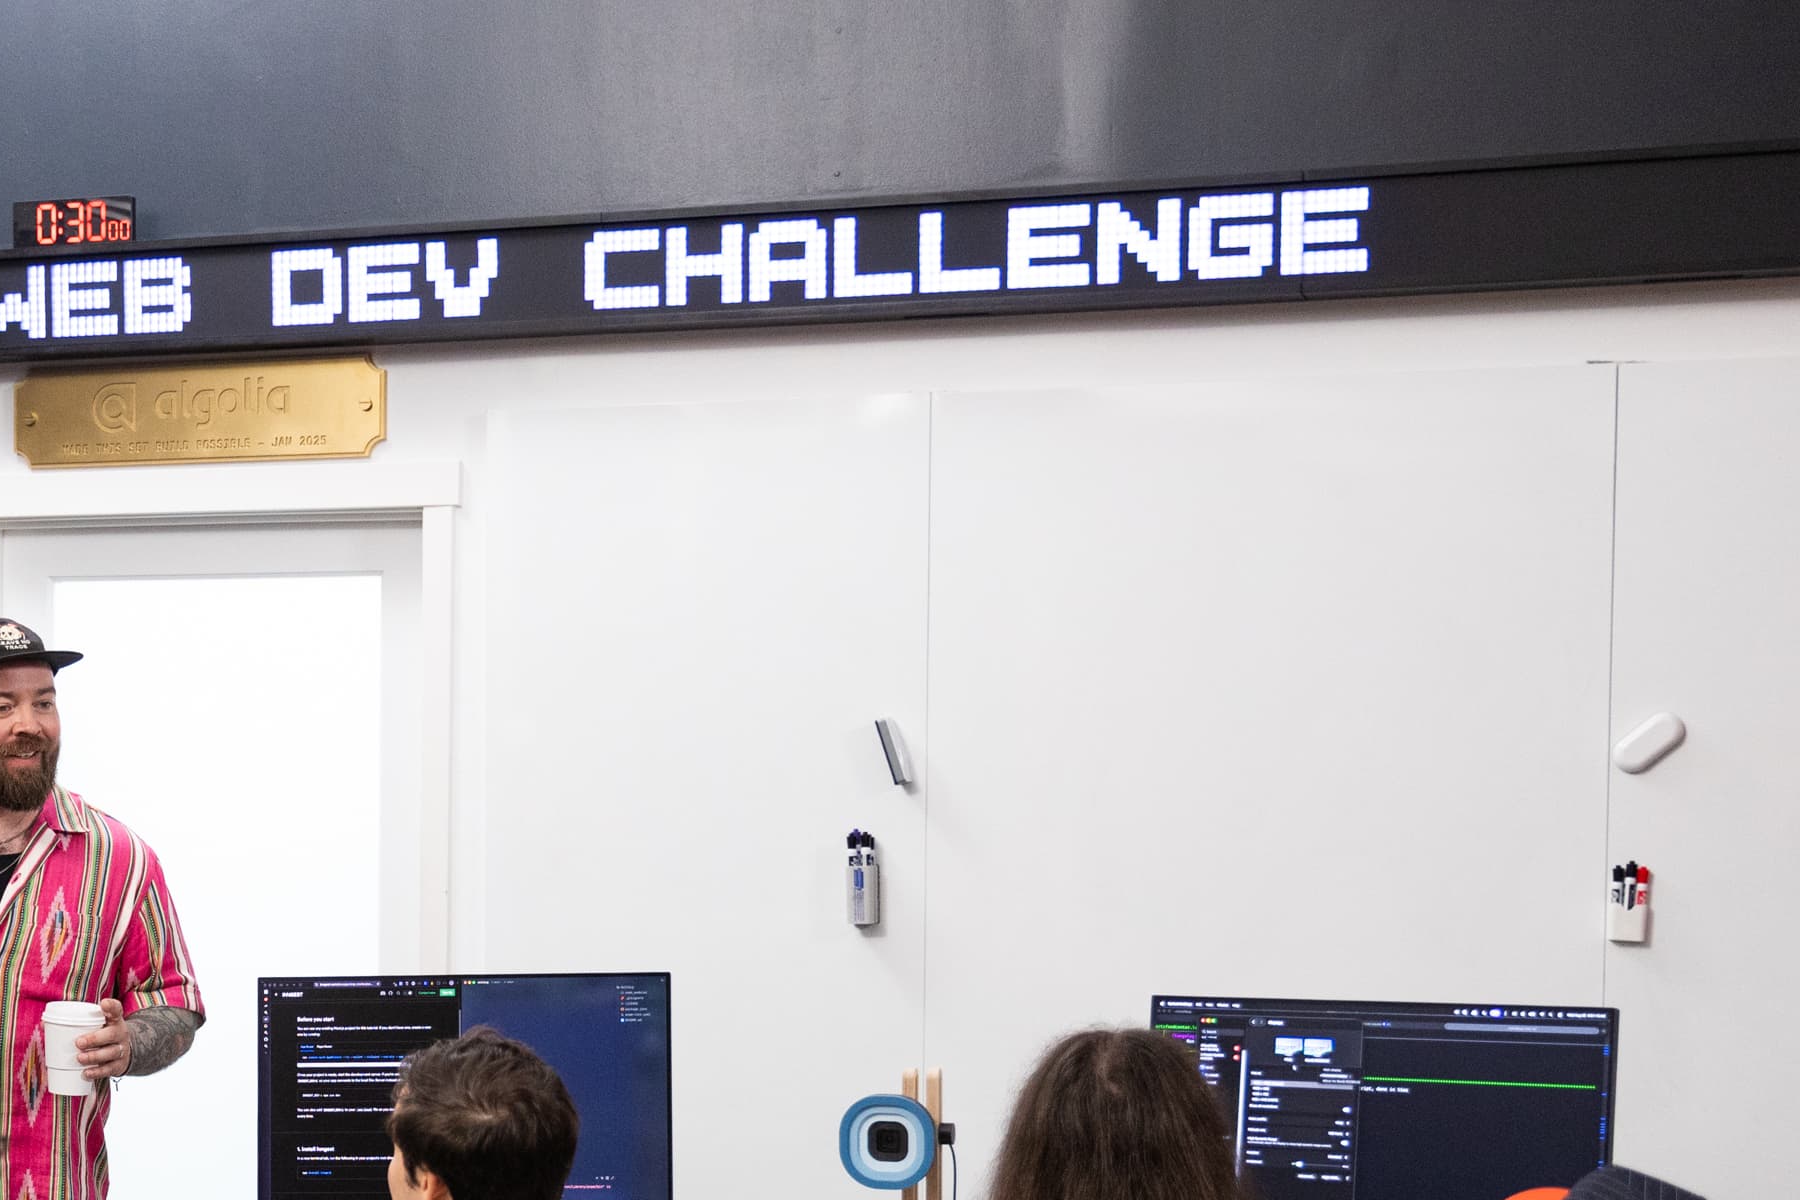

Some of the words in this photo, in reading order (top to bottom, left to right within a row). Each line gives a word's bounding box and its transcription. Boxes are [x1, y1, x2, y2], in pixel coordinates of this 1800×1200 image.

[36, 200, 106, 245] 0:30
[108, 219, 131, 241] 00
[271, 238, 498, 326] DEV
[584, 187, 1369, 310] CHALLENGE
[154, 376, 291, 430] algolia
[62, 443, 89, 457] MADE
[96, 442, 121, 455] THIS
[128, 440, 149, 454] SET
[156, 439, 189, 453] BUILD
[196, 437, 251, 451] POSSIBLE
[271, 435, 293, 448] JAN
[299, 434, 327, 447] 2025
